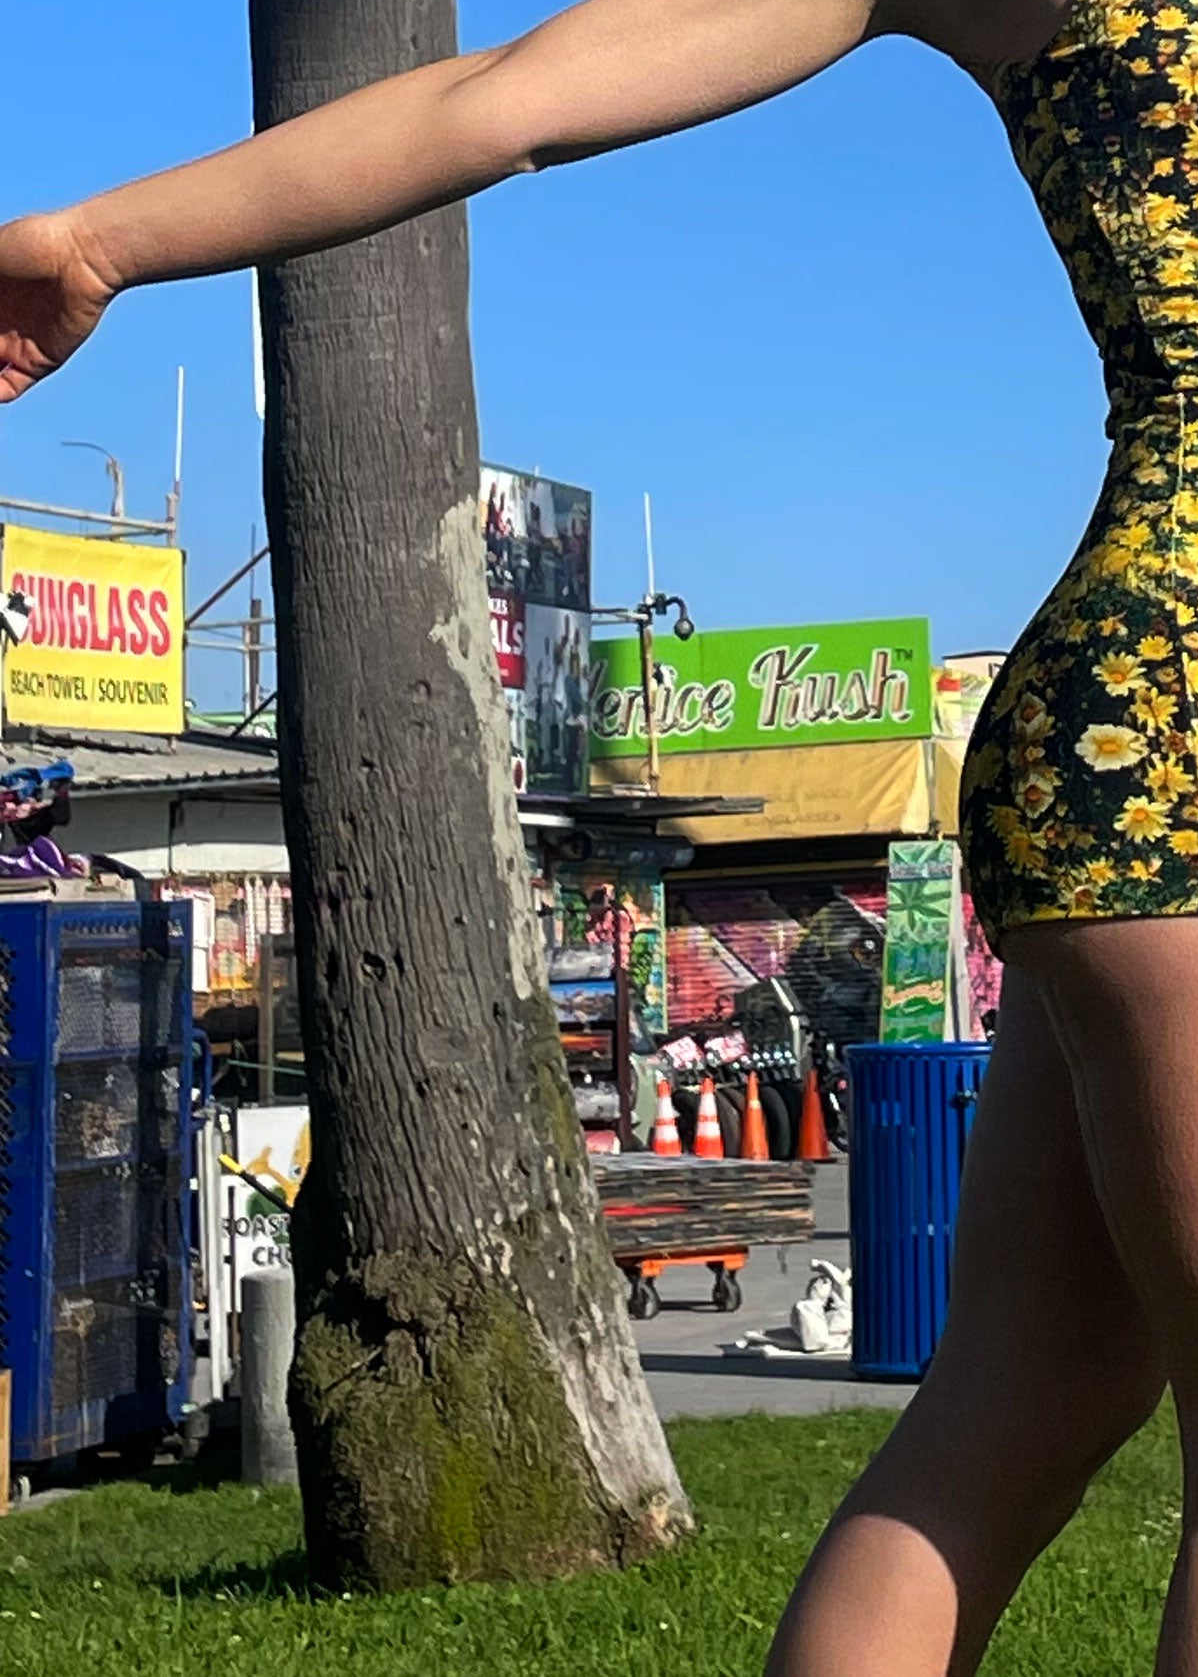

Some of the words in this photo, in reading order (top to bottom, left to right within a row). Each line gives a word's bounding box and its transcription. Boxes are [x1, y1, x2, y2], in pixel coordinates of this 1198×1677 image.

[10, 669, 45, 696] BEACH
[46, 673, 88, 701] TOWEL
[98, 678, 169, 705] SOUVENIR
[749, 643, 914, 730] Kush
